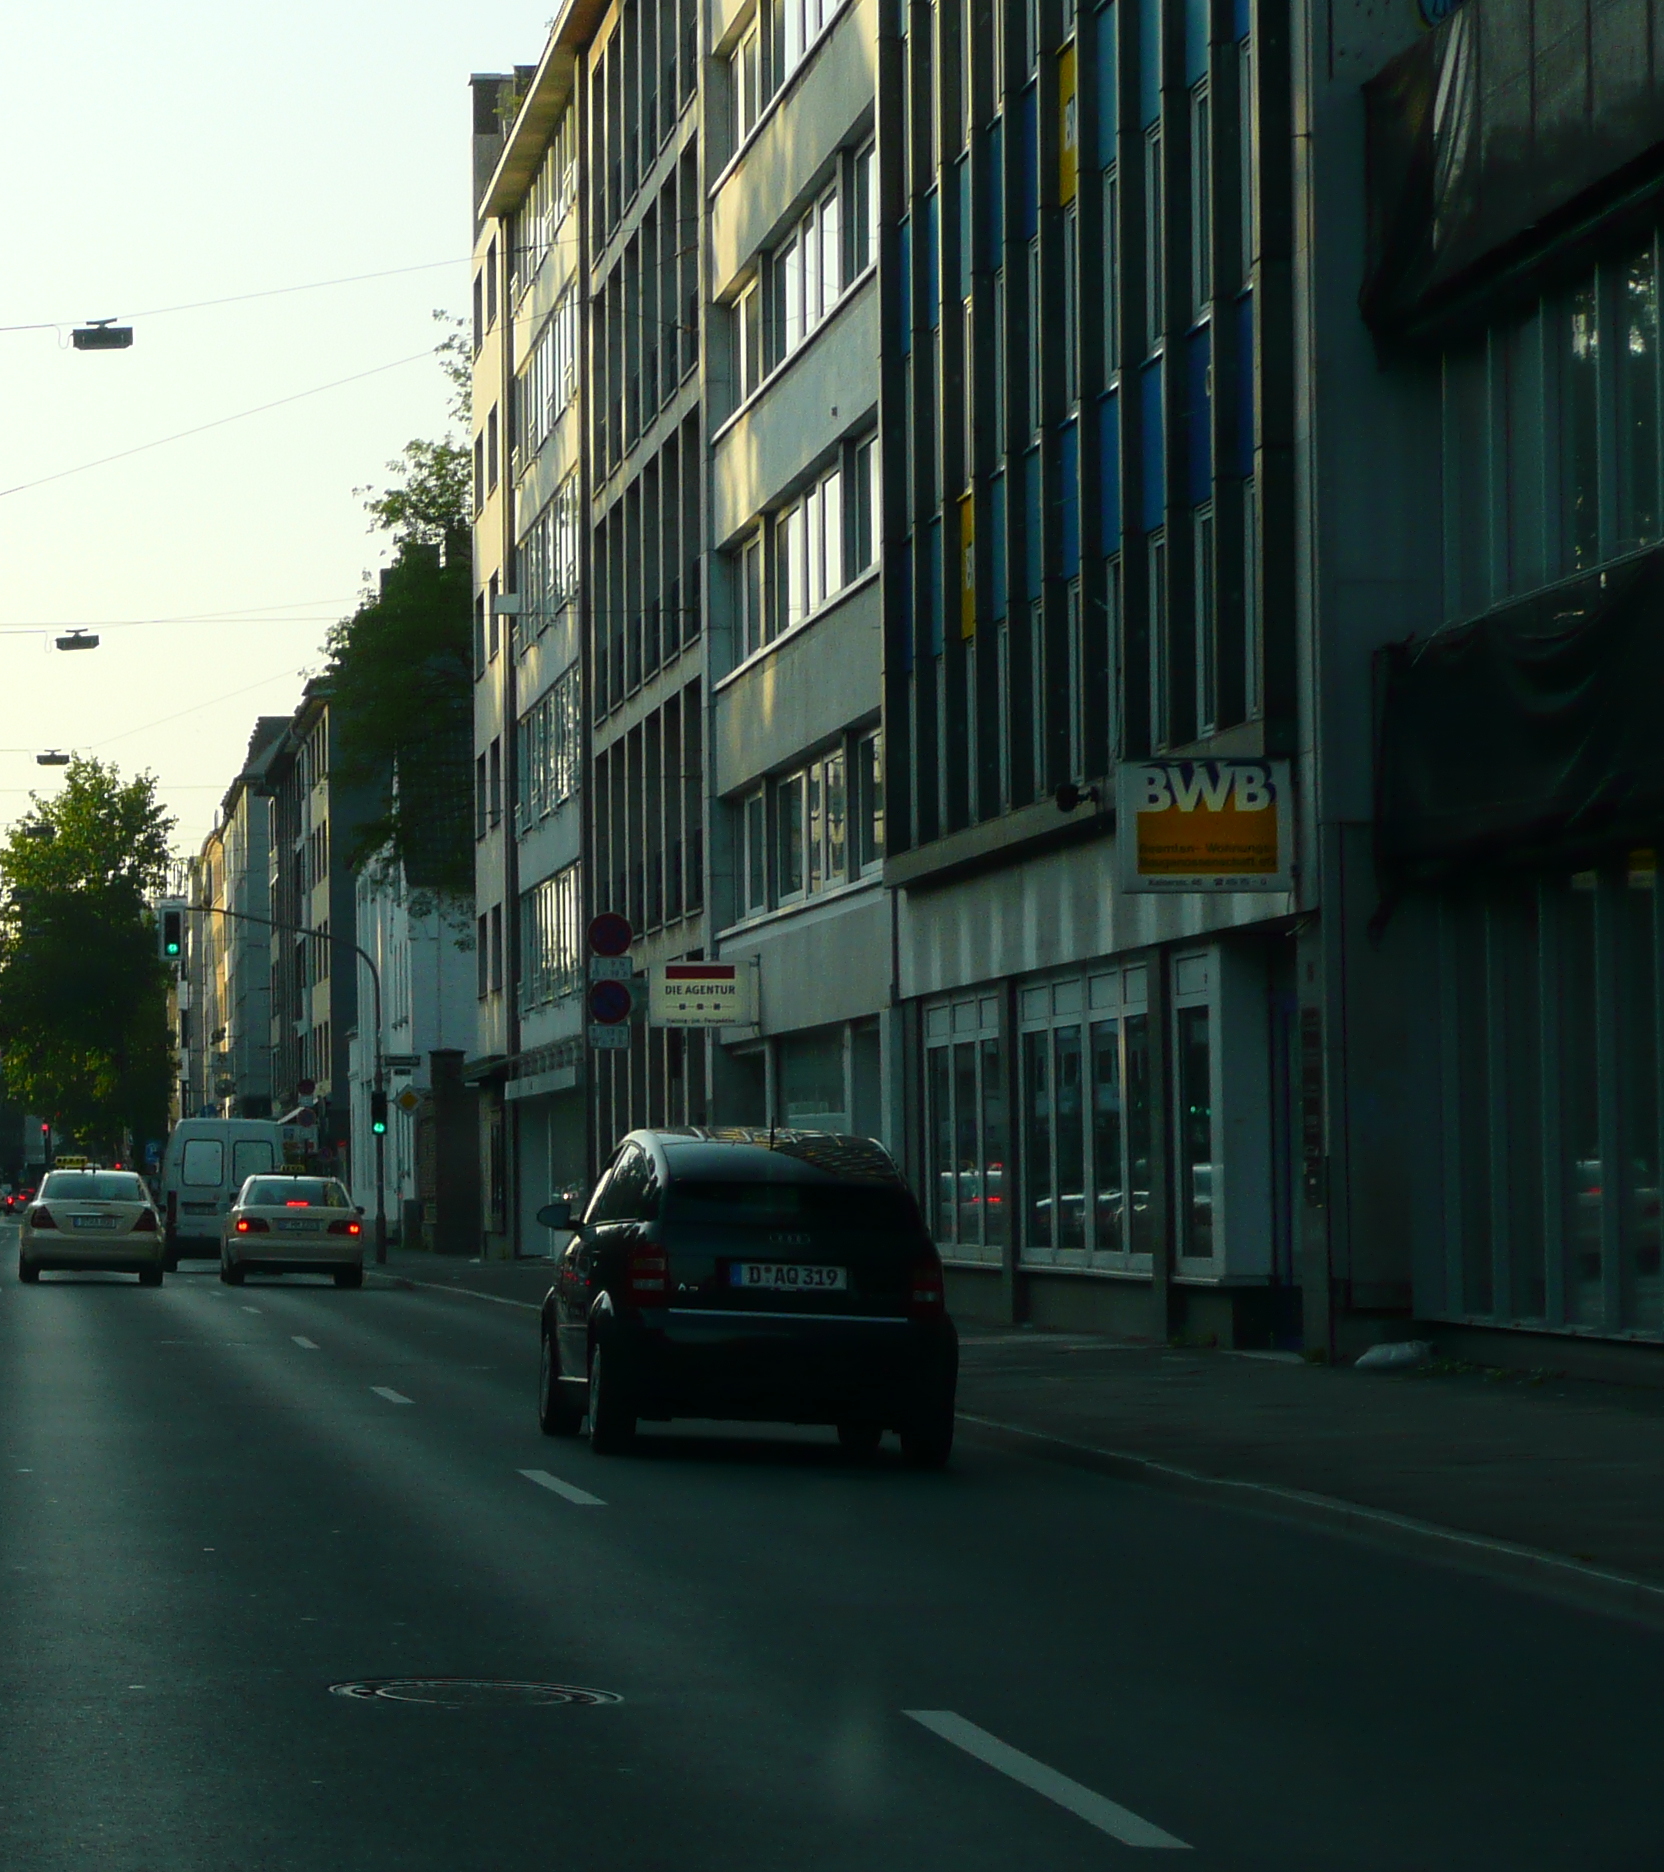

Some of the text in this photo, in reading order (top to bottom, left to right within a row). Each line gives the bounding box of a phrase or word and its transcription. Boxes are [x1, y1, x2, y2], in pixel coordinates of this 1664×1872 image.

[1137, 764, 1272, 812] BWB
[665, 985, 735, 995] DIE AGENTUR
[749, 1266, 838, 1286] D AQ 319
